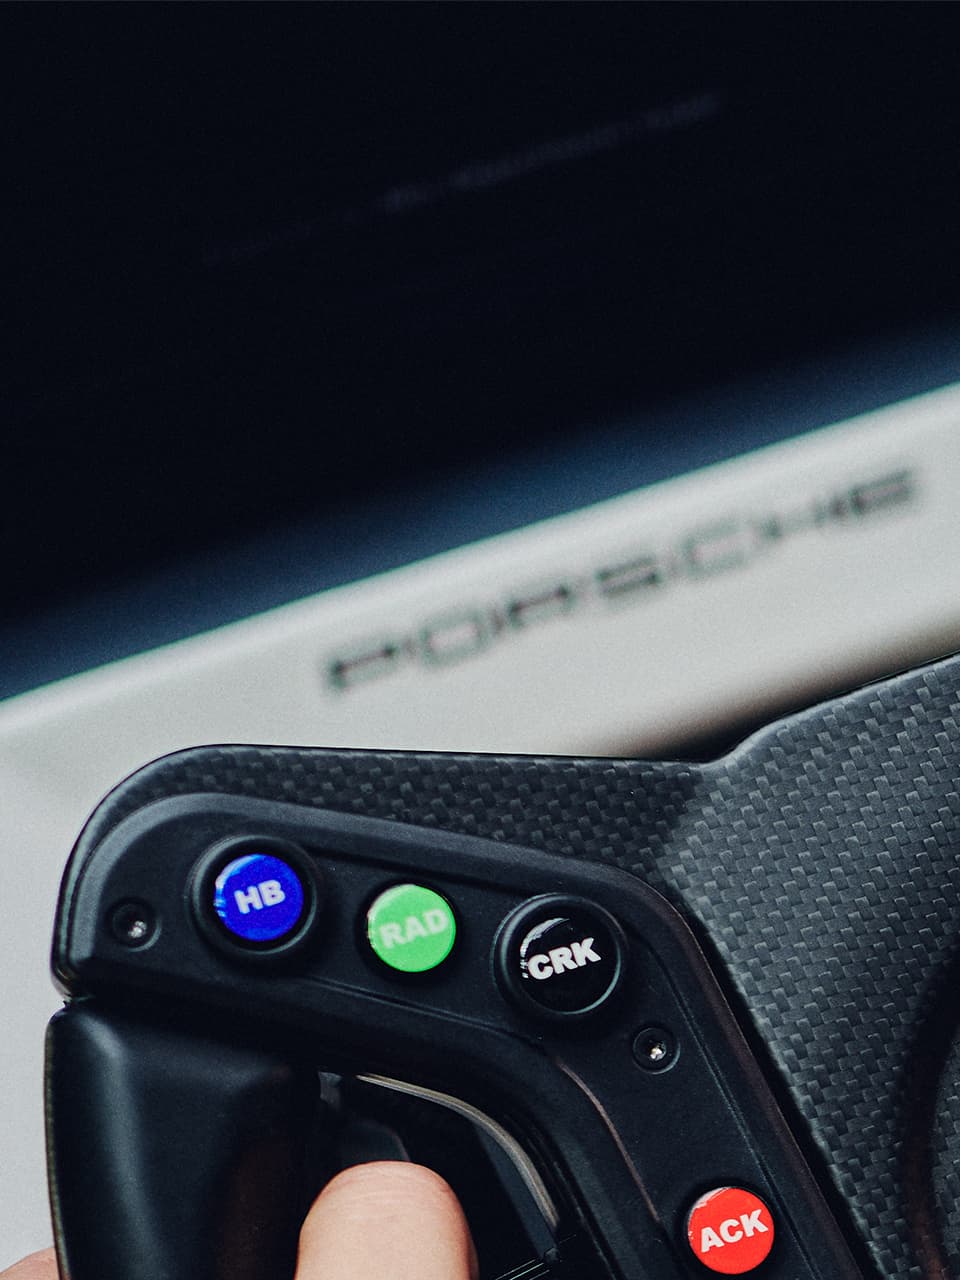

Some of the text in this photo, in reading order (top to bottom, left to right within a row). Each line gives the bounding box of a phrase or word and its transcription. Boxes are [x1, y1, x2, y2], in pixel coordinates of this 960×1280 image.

[326, 468, 918, 690] PORSCHE
[234, 879, 286, 914] HB
[379, 908, 449, 949] RAD
[527, 937, 601, 981] CRK
[699, 1209, 769, 1253] ACK
